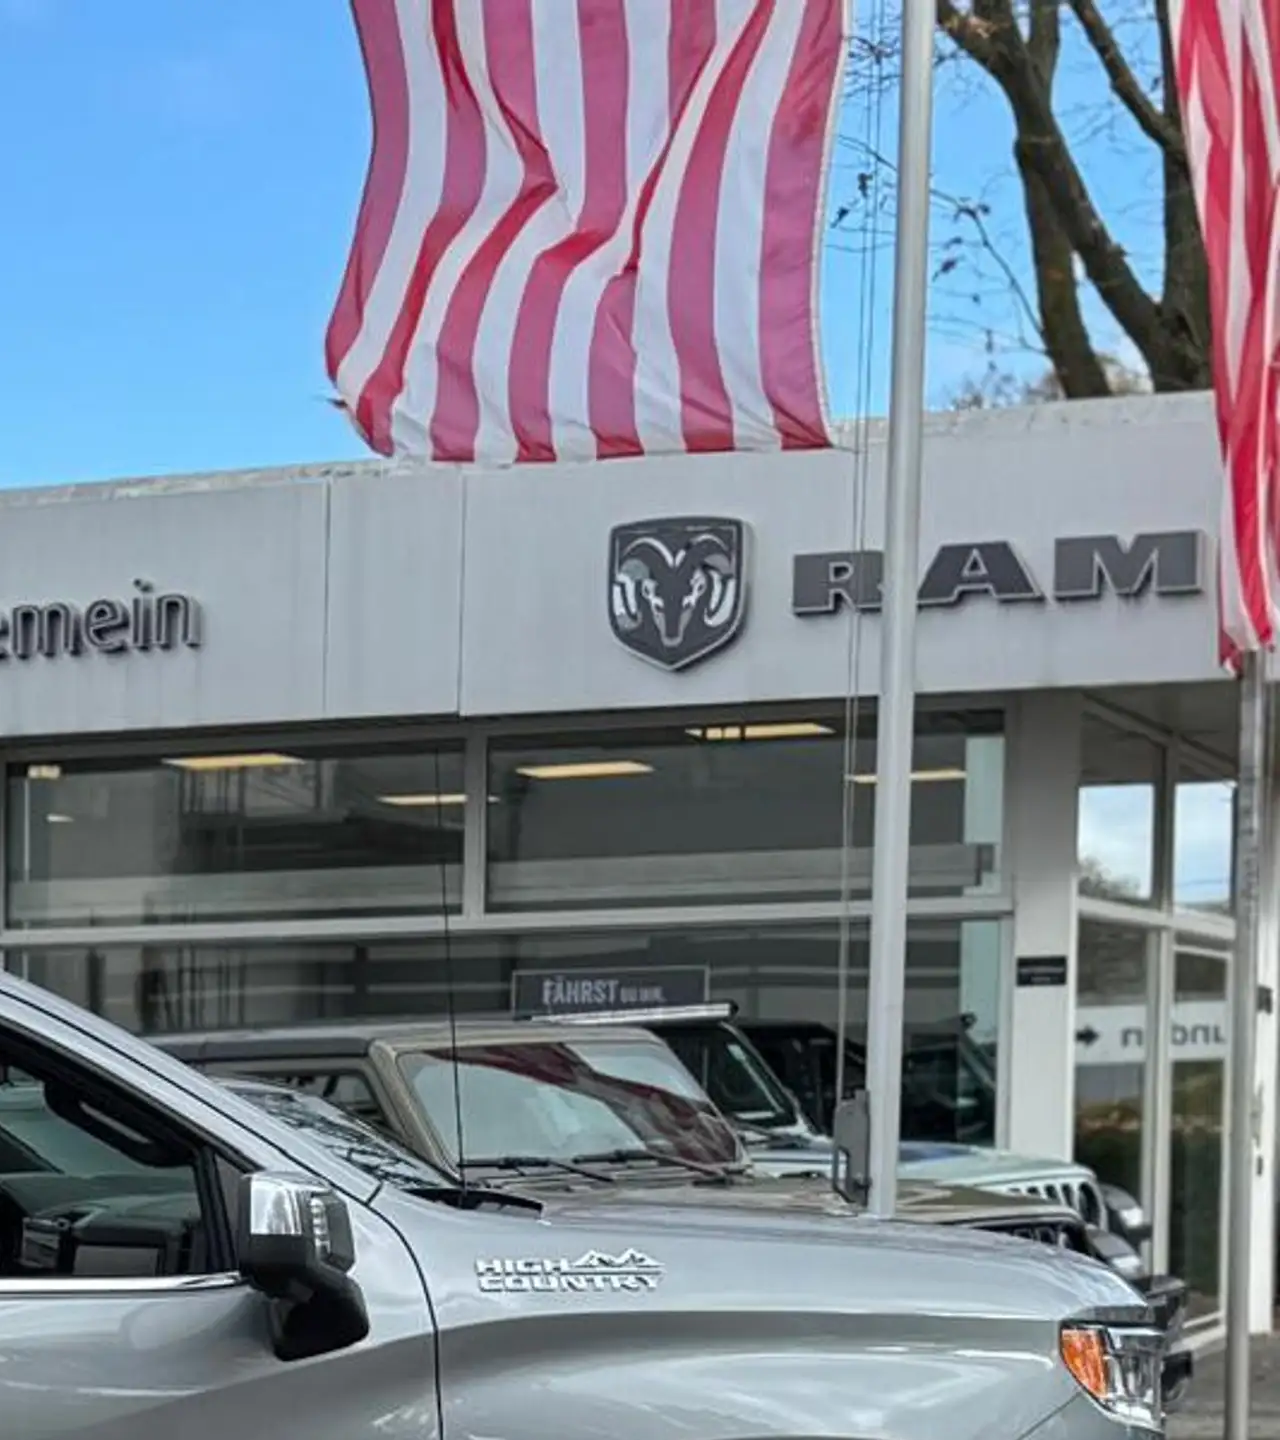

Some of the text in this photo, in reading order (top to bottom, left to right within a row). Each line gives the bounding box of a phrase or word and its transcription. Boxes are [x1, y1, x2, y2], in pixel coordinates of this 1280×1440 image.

[793, 529, 1207, 615] RAM
[476, 1258, 571, 1275] HIGH
[478, 1274, 663, 1293] COUNTRY
